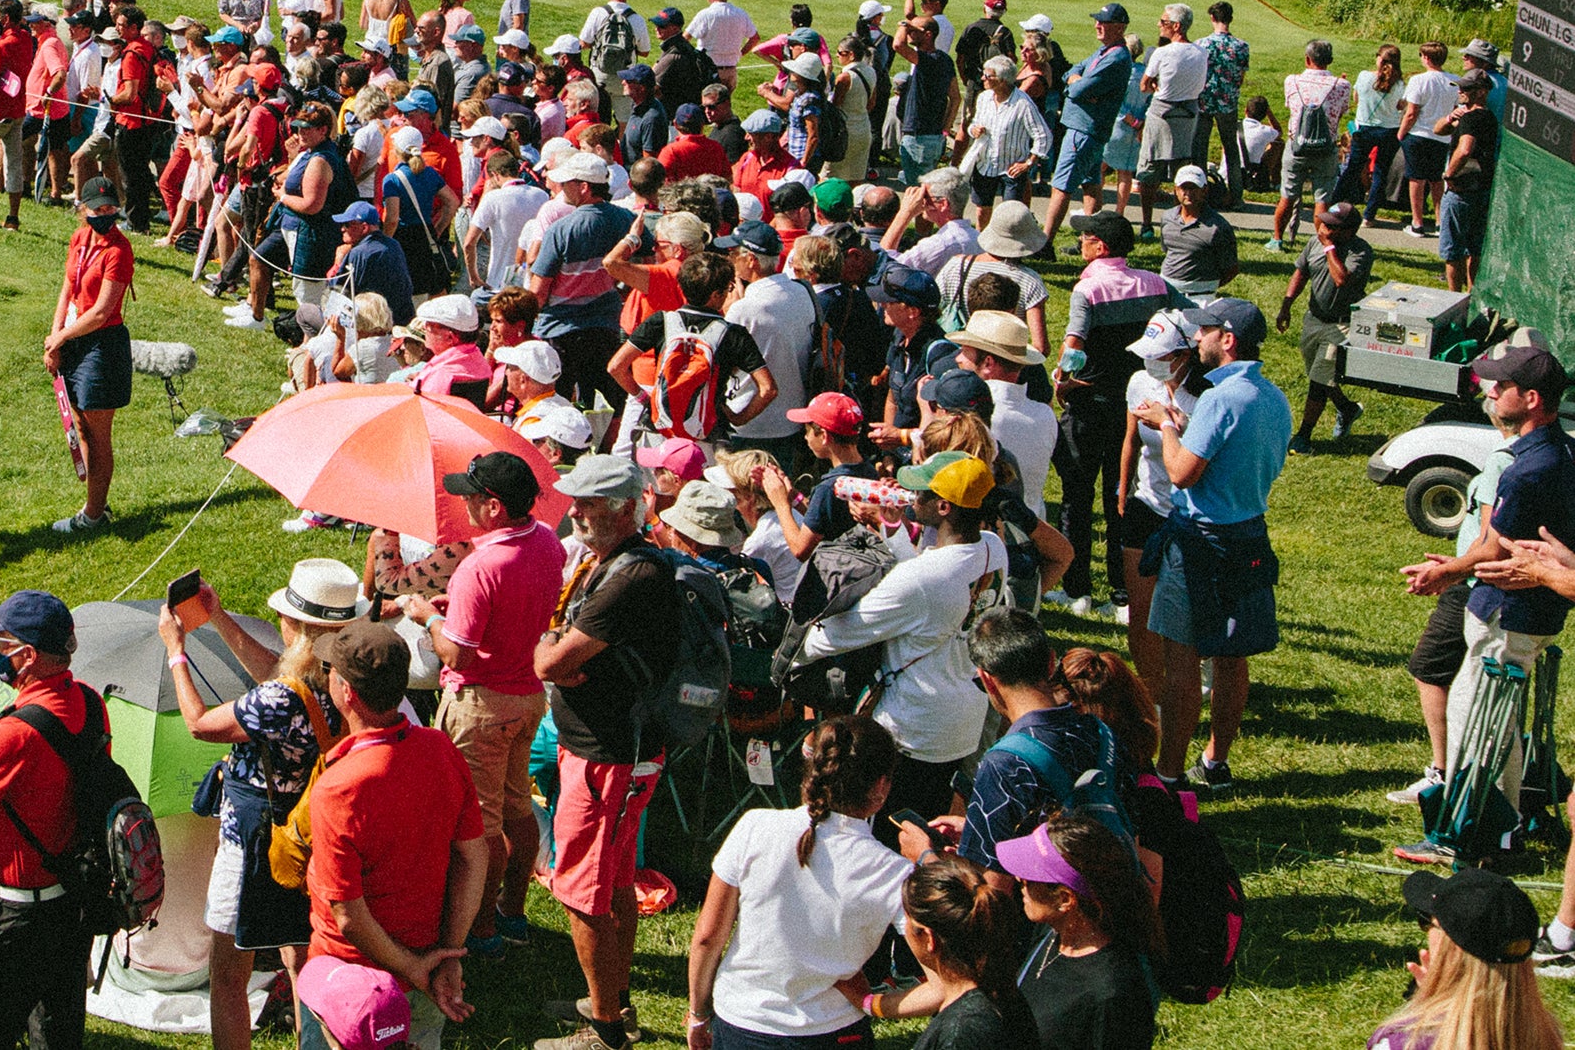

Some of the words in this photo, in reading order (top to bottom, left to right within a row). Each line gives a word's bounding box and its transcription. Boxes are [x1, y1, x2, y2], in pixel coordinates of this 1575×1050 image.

[1519, 7, 1553, 39] CHUN,
[1523, 41, 1533, 62] 9
[1512, 68, 1546, 103] YANG,
[1547, 90, 1560, 108] A.
[1511, 102, 1527, 128] 10
[1543, 120, 1561, 145] 66
[375, 1024, 405, 1042] Titleist
